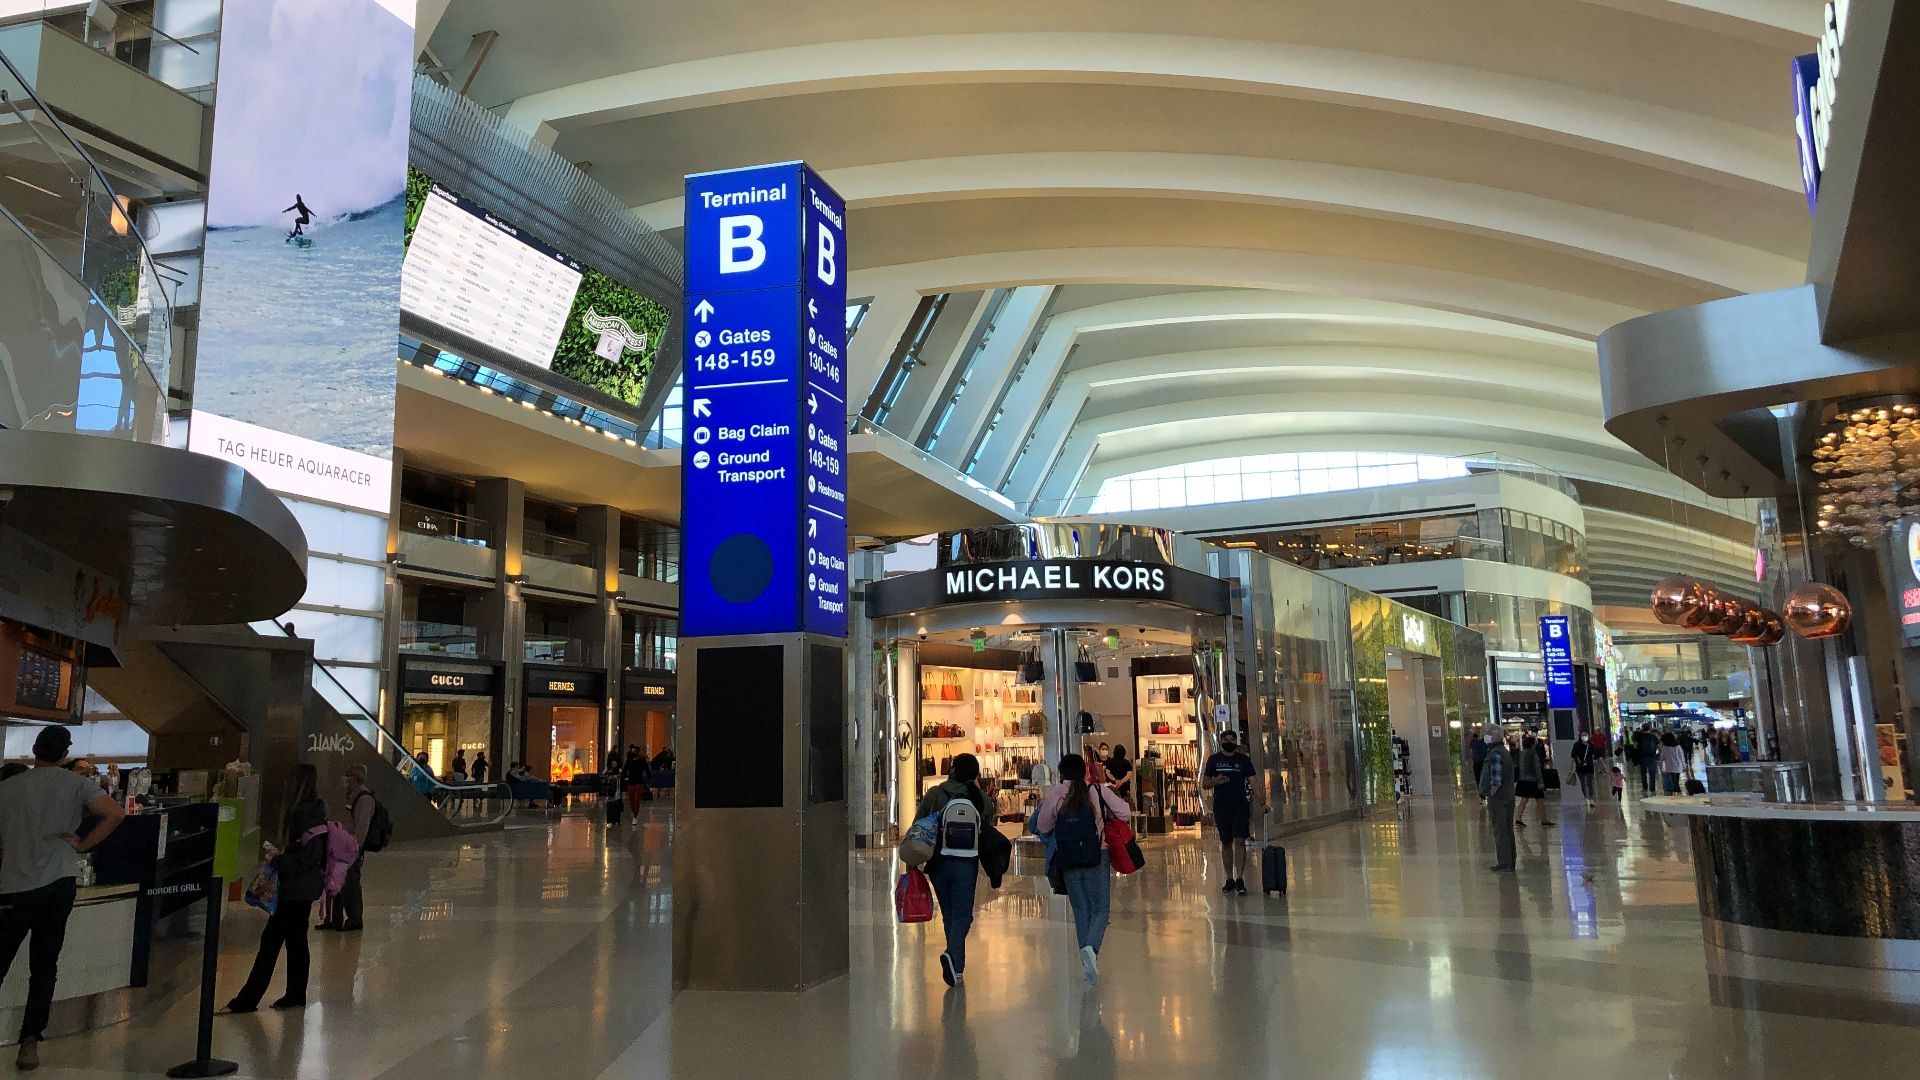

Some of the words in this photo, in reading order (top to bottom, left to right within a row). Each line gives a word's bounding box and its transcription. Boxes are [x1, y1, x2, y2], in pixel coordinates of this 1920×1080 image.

[432, 184, 458, 204] Departures
[701, 183, 787, 208] Terminal
[810, 187, 842, 230] Terminal
[719, 214, 767, 275] B
[817, 221, 836, 286] B
[587, 315, 620, 330] AMERICAN
[619, 325, 643, 347] EXPRESS
[719, 329, 770, 345] Gates
[818, 333, 838, 358] Gates
[694, 349, 776, 372] 148-159
[808, 350, 840, 384] 130-146
[718, 427, 746, 442] Bag
[750, 424, 790, 438] Claim
[818, 428, 838, 452] Gates
[218, 438, 245, 457] TAG
[250, 445, 294, 469] HEUER
[297, 458, 372, 487] AQUARACER
[718, 450, 770, 466] Ground
[808, 448, 840, 476] 148-159
[718, 467, 786, 484] Transport
[818, 481, 845, 503] Restrooms
[818, 552, 829, 569] Bag
[830, 556, 844, 572] Claim
[818, 578, 838, 595] Ground
[946, 565, 1080, 595] MICHAEL
[1094, 565, 1166, 592] KORS
[818, 596, 844, 614] Transport
[1549, 624, 1562, 638] B
[431, 674, 464, 686] GUCCI
[1669, 686, 1709, 696] 150-159
[147, 885, 178, 896] BORDER
[180, 882, 202, 893] GRILL
